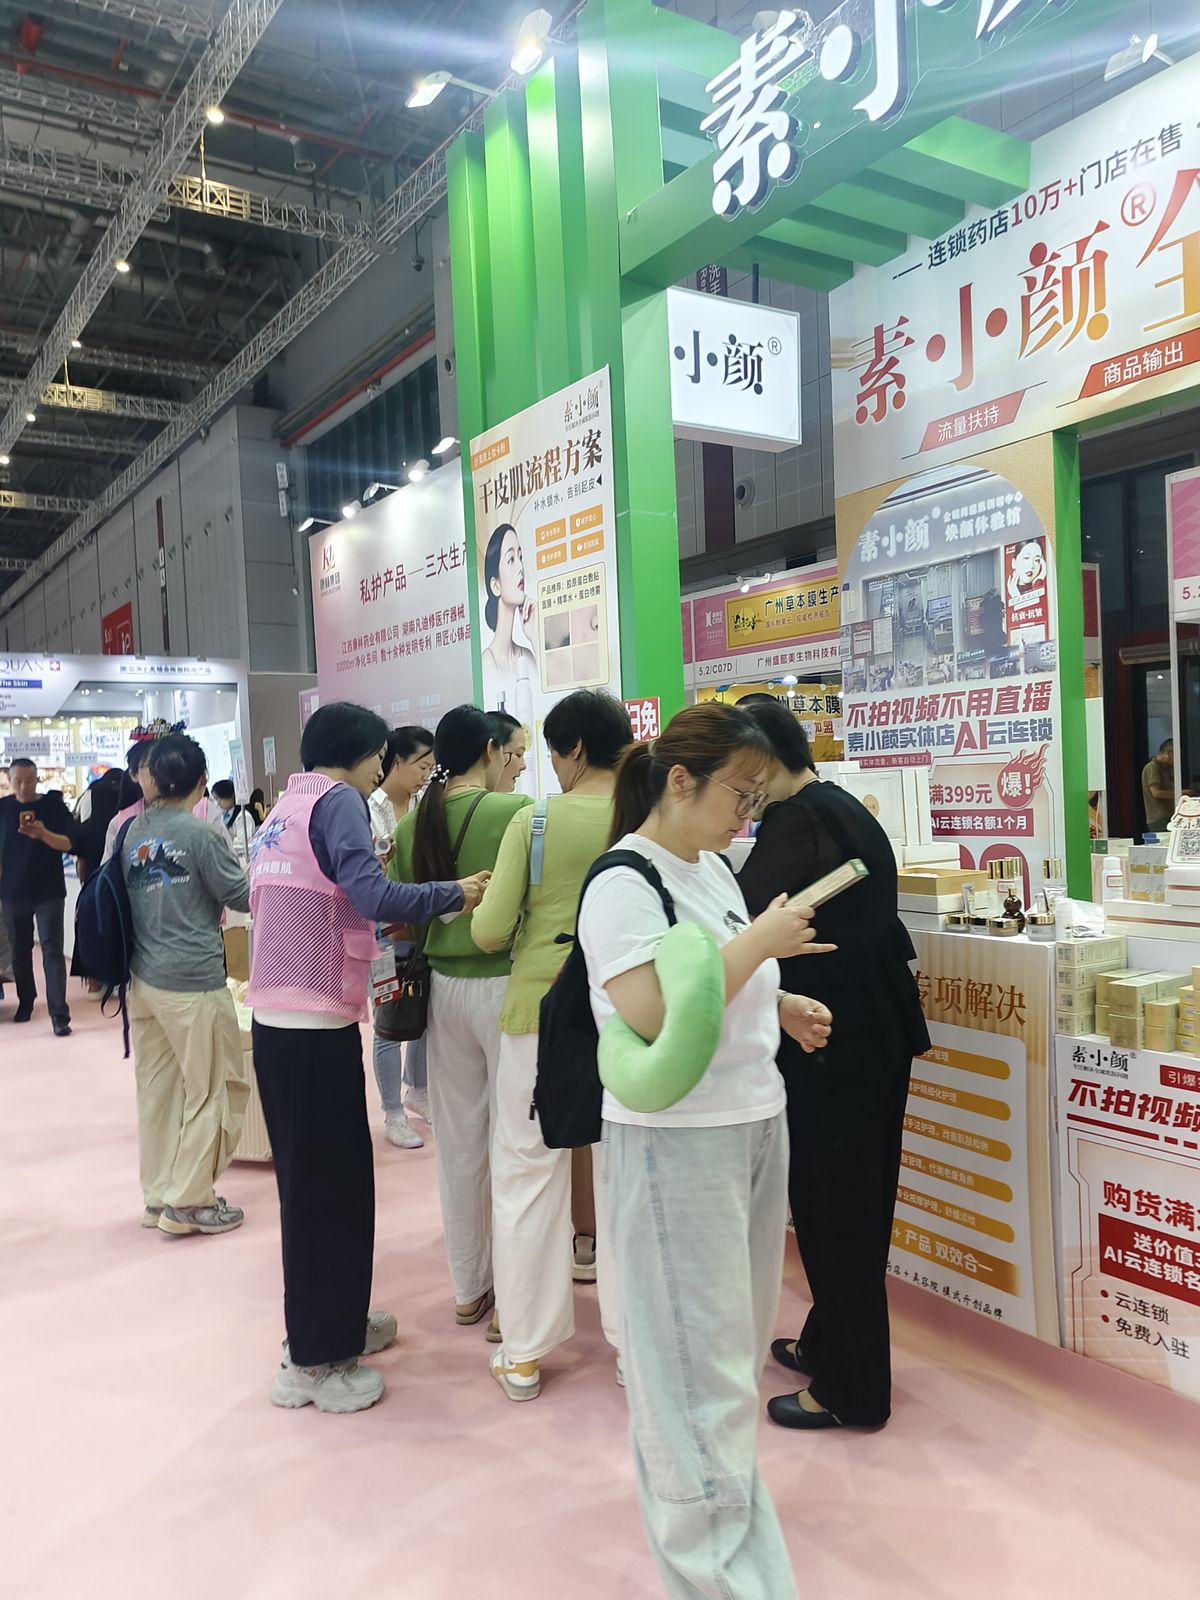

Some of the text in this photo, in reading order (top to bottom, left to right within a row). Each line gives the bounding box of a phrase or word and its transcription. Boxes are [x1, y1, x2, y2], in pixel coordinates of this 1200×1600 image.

[1103, 341, 1184, 387] 商品输出
[937, 405, 1000, 442] 流量扶持
[478, 429, 603, 514] 干皮肌流程方案
[1182, 584, 1200, 600] 5.
[847, 680, 1054, 728] 不拍视频不用直播
[848, 717, 1053, 757] 素小颜实体店AI云连锁
[1168, 1071, 1200, 1088] 引爆
[1103, 1180, 1200, 1233] 购货满
[935, 1240, 994, 1273] 双效合一
[1115, 1291, 1170, 1326] 云连锁
[1115, 1317, 1191, 1360] 免费入驻
